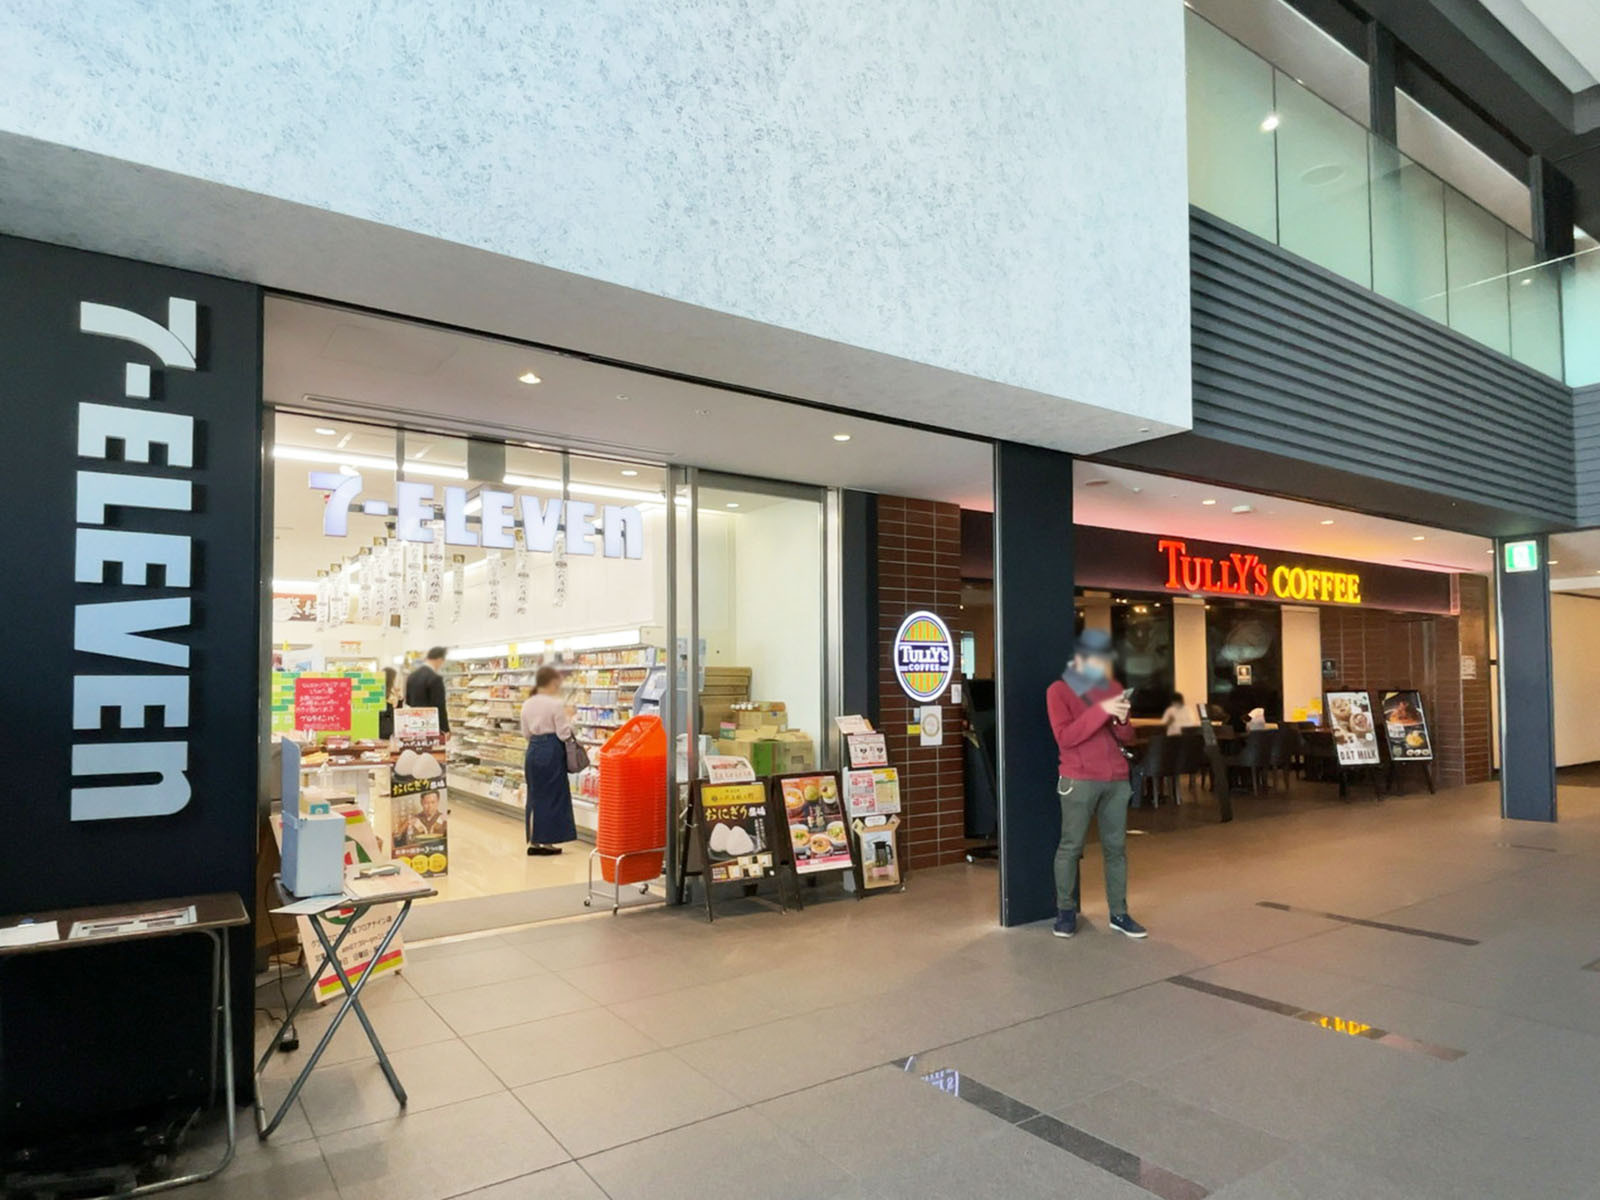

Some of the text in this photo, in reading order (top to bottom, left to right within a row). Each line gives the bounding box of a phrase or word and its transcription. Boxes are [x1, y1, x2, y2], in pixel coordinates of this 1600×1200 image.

[1158, 540, 1361, 604] TULLY'S COFFEE
[900, 645, 949, 664] TULLY'S
[1340, 749, 1376, 760] OAT MILK
